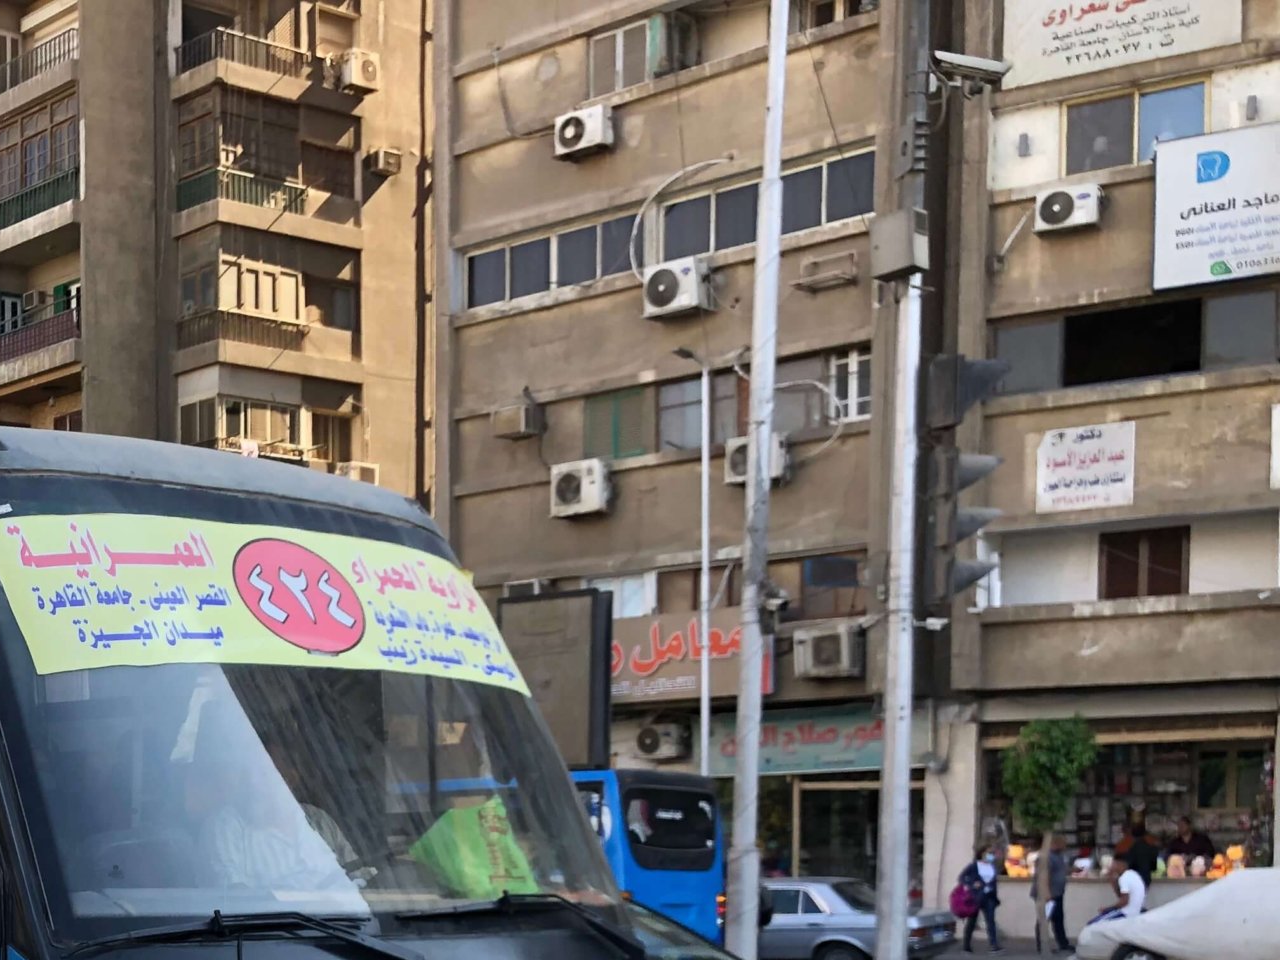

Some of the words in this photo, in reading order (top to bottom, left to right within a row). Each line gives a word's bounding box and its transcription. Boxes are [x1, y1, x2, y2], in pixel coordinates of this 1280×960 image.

[6, 522, 215, 579] العمرانية
[31, 582, 93, 616] القاهرة
[88, 581, 136, 612] جامعة
[194, 583, 233, 612] القصر
[248, 563, 357, 629] ٤٢٤
[72, 619, 160, 649] الجيزة
[165, 621, 224, 647] ميدان
